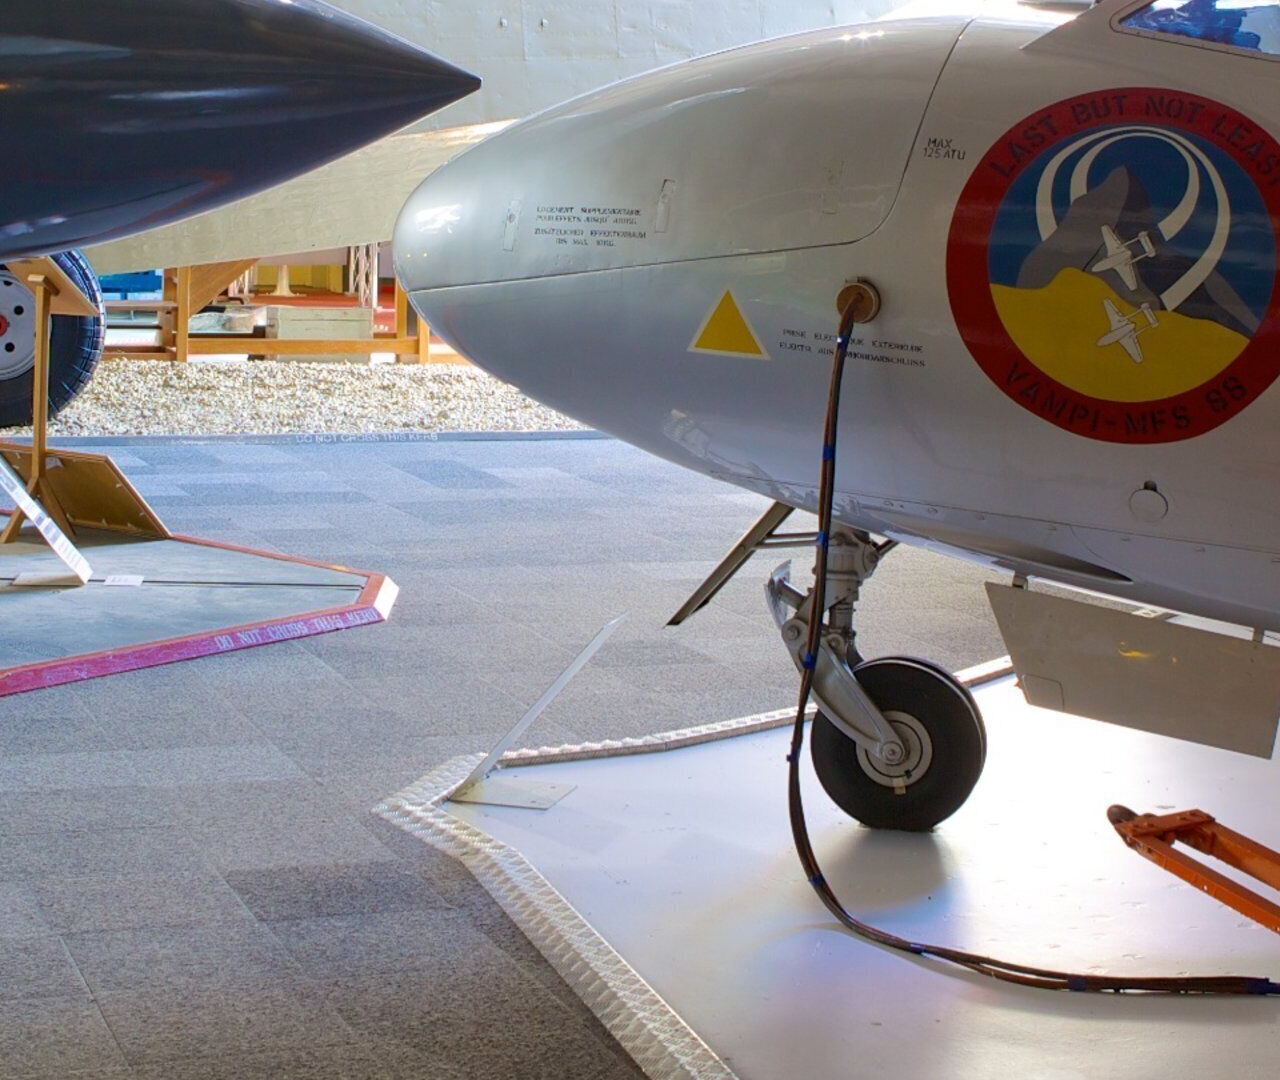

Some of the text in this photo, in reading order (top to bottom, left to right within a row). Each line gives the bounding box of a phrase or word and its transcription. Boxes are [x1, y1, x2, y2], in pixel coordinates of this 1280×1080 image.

[927, 137, 953, 149] MAX
[990, 114, 1056, 179] LAST
[1070, 95, 1128, 125] BUT
[1145, 95, 1206, 124] NOT
[923, 147, 942, 159] 125
[215, 634, 235, 650] DO
[237, 629, 262, 644] NOT
[267, 621, 309, 640] CROSS
[314, 614, 344, 631] THIS
